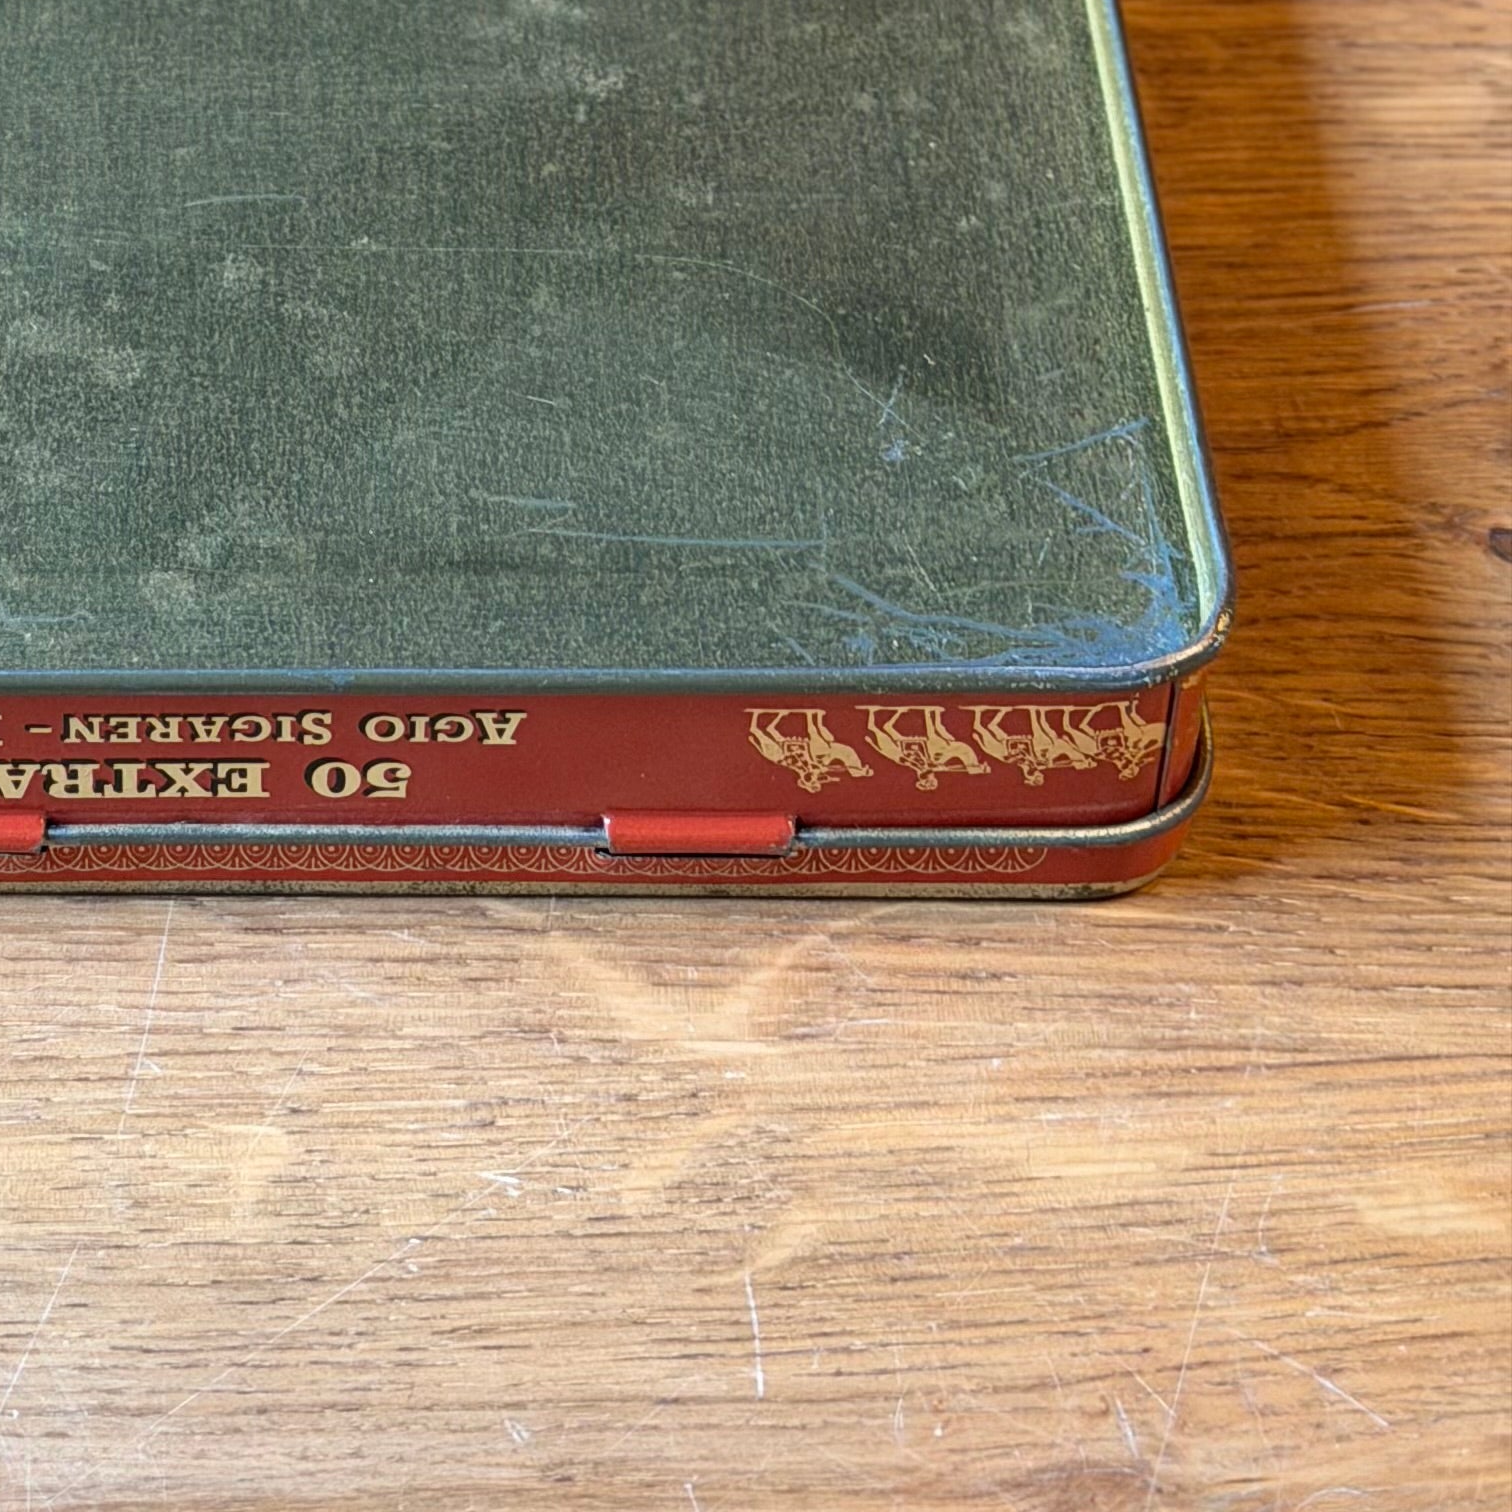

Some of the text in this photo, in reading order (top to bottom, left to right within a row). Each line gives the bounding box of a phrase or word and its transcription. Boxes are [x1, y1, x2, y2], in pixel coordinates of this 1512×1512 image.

[62, 712, 332, 746] SIGAREN
[364, 712, 528, 745] AGIO
[310, 761, 412, 798] 50
